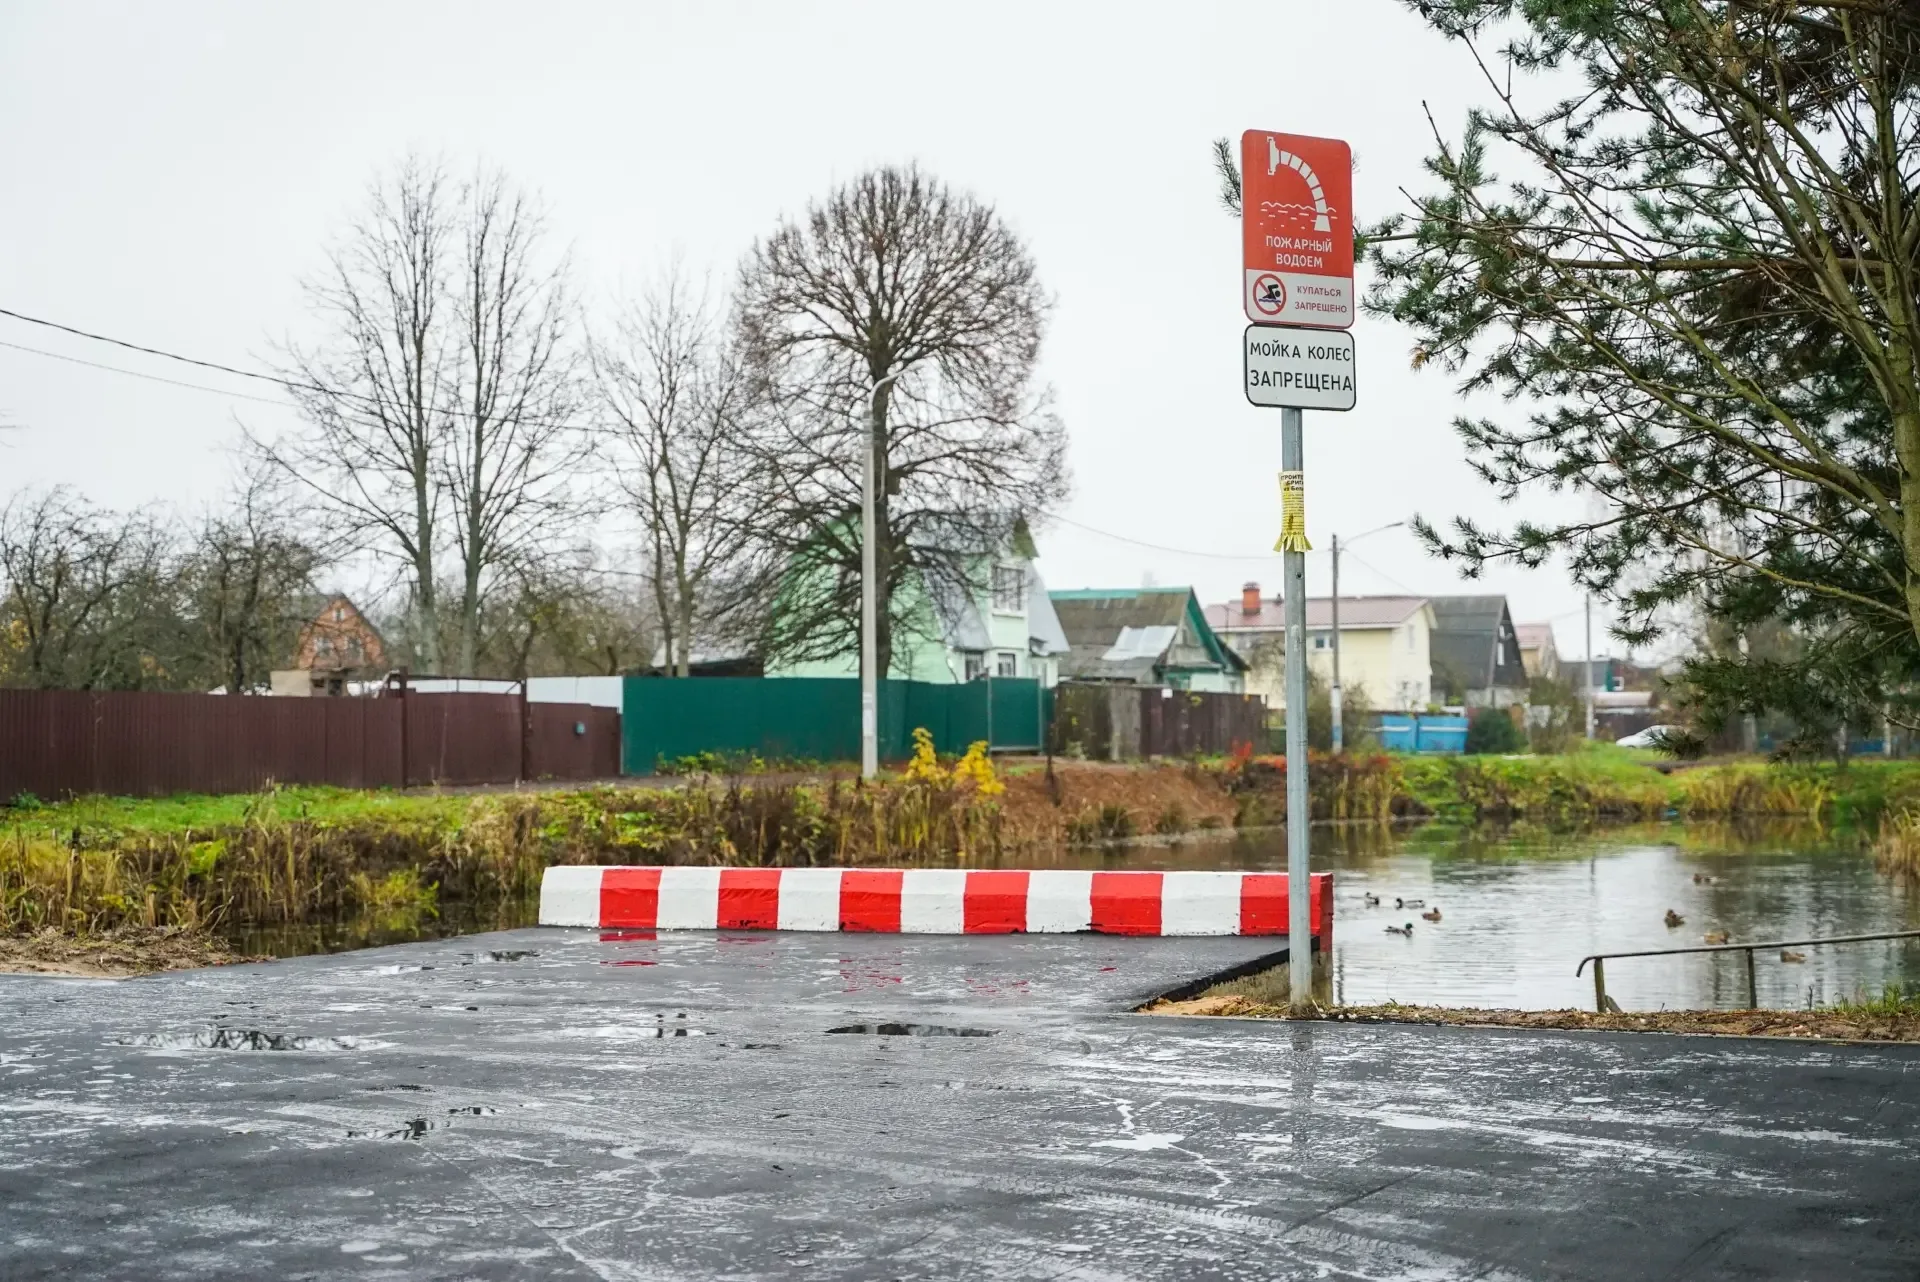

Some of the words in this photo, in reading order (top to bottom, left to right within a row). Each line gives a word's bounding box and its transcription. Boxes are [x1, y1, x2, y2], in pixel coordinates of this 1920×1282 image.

[1266, 235, 1332, 252] ПОЖАРНЫЙ
[1276, 253, 1323, 268] ВОДОЕМ
[1297, 285, 1341, 297] КУПАТЬСЯ
[1295, 301, 1347, 313] ЗАПРЕЩЕНО
[1250, 340, 1301, 358] МОЙКА
[1308, 345, 1351, 361] КОЛЕС
[1250, 369, 1353, 392] ЗАПРЕЩЕНА
